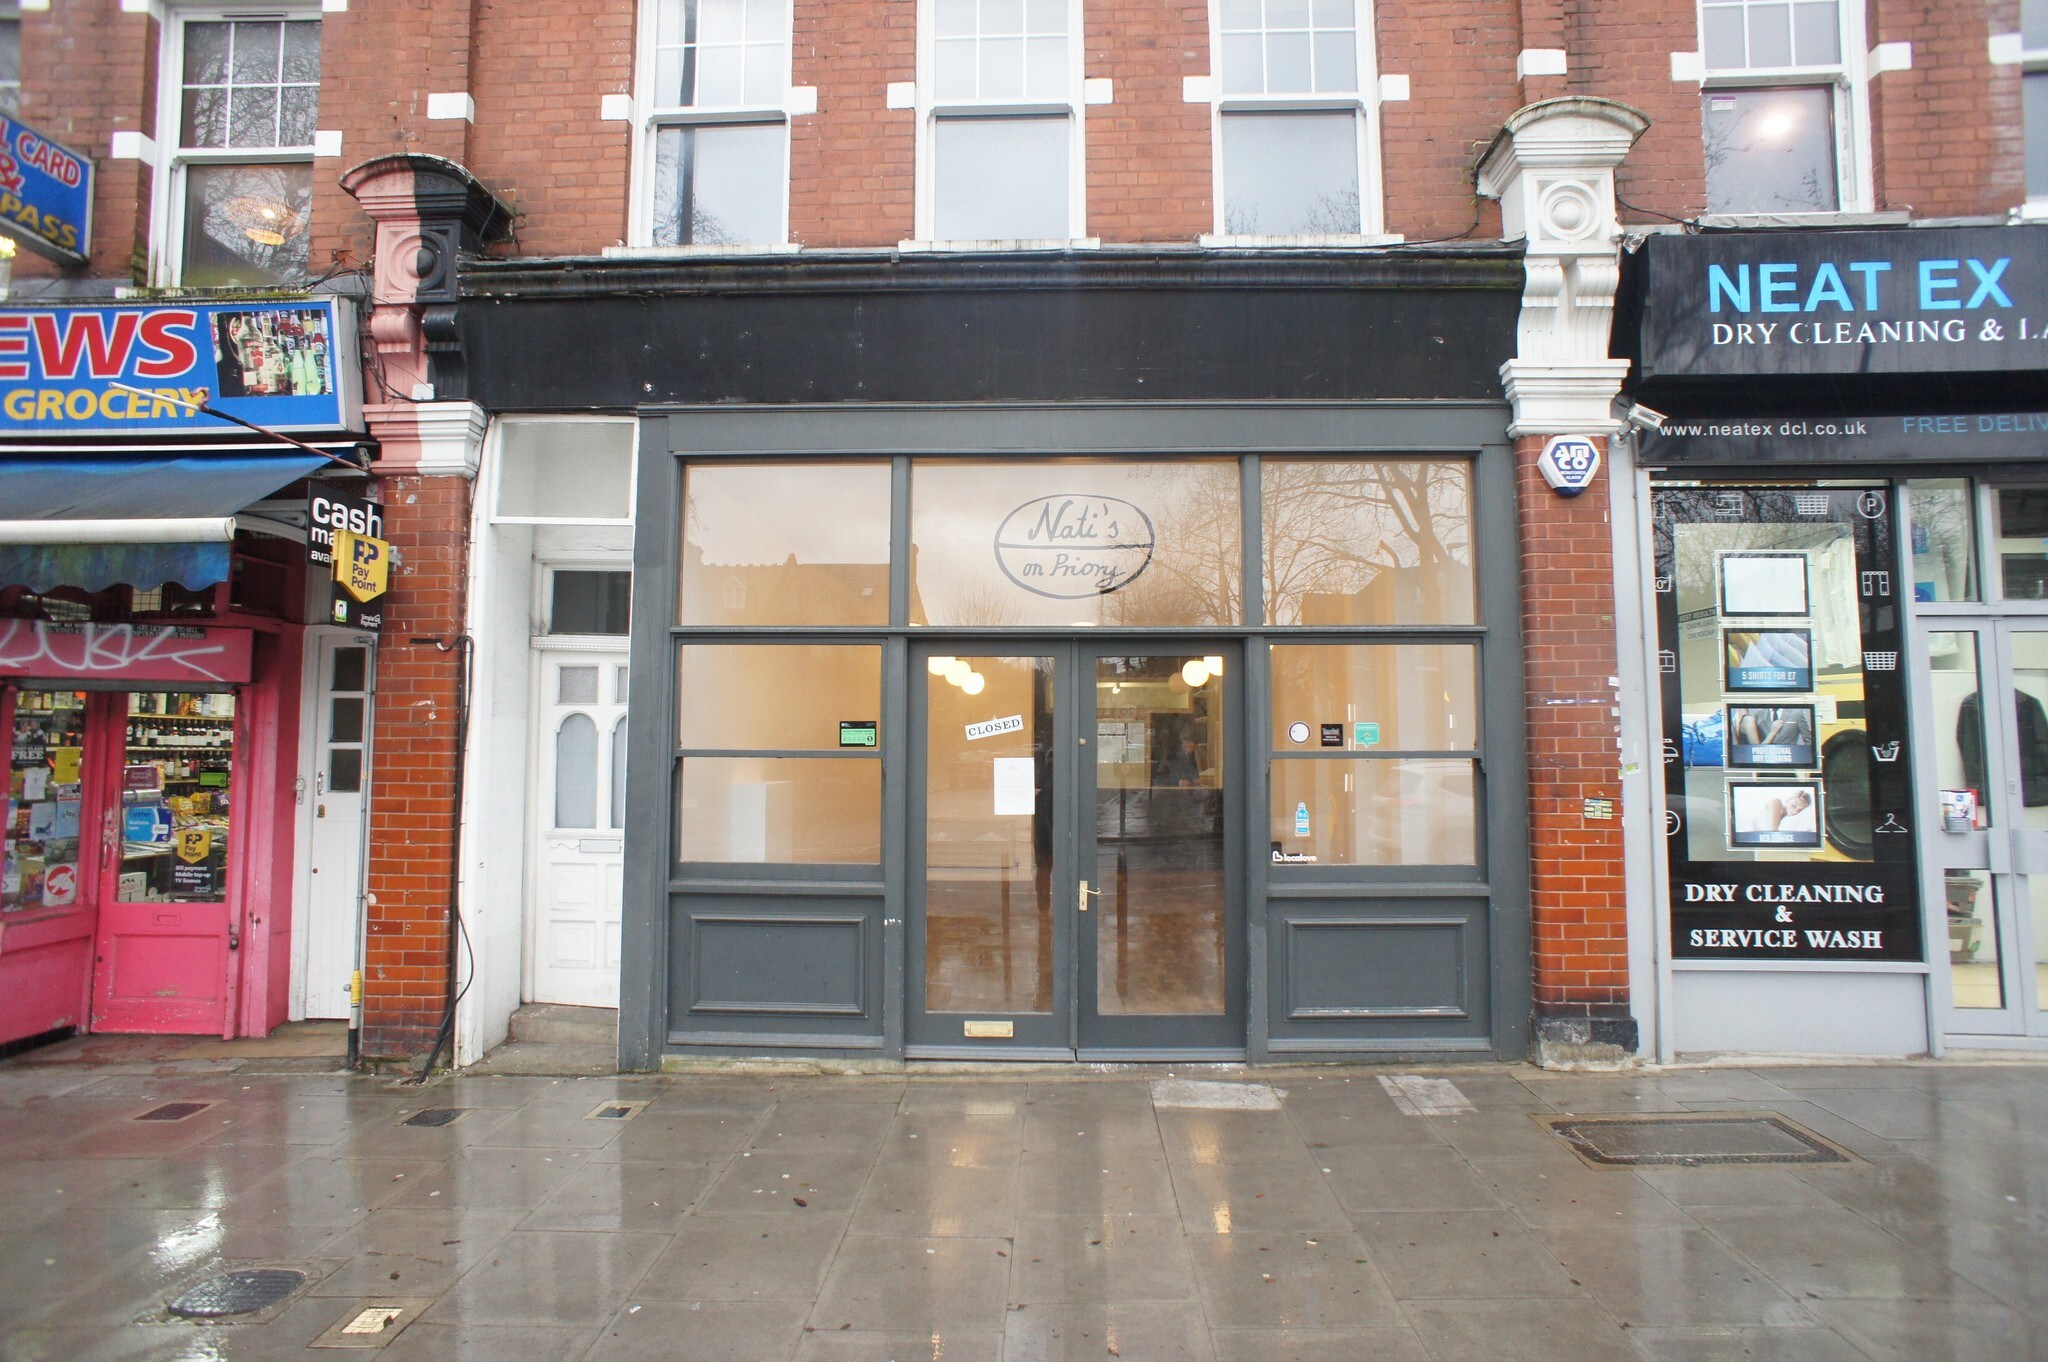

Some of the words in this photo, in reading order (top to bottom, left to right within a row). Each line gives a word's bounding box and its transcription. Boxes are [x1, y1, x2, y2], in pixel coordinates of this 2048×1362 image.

[17, 130, 81, 188] CARD
[0, 192, 78, 248] PASS
[1709, 262, 1891, 313] NEAT
[1919, 258, 2014, 310] EX
[1712, 323, 1778, 345] DRY
[1790, 319, 1966, 345] CLEANING
[1979, 319, 2004, 341] &
[4, 387, 206, 421] GROCERY
[1660, 422, 1773, 437] www.neatex
[1780, 421, 1867, 436] dcl.co.uk
[1903, 416, 1968, 433] FREE
[313, 497, 382, 541] cash
[1028, 500, 1119, 542] Nati's
[352, 563, 370, 581] Pay
[1022, 562, 1044, 577] on
[1049, 553, 1126, 588] Priory
[351, 575, 377, 593] Point
[1742, 671, 1747, 680] 5
[968, 718, 1021, 737] CLOSED
[1685, 884, 1738, 902] DRY
[1745, 885, 1884, 903] CLEANING
[1775, 905, 1793, 922] &
[1690, 929, 1797, 948] SERVICE
[1804, 930, 1883, 949] WASH
